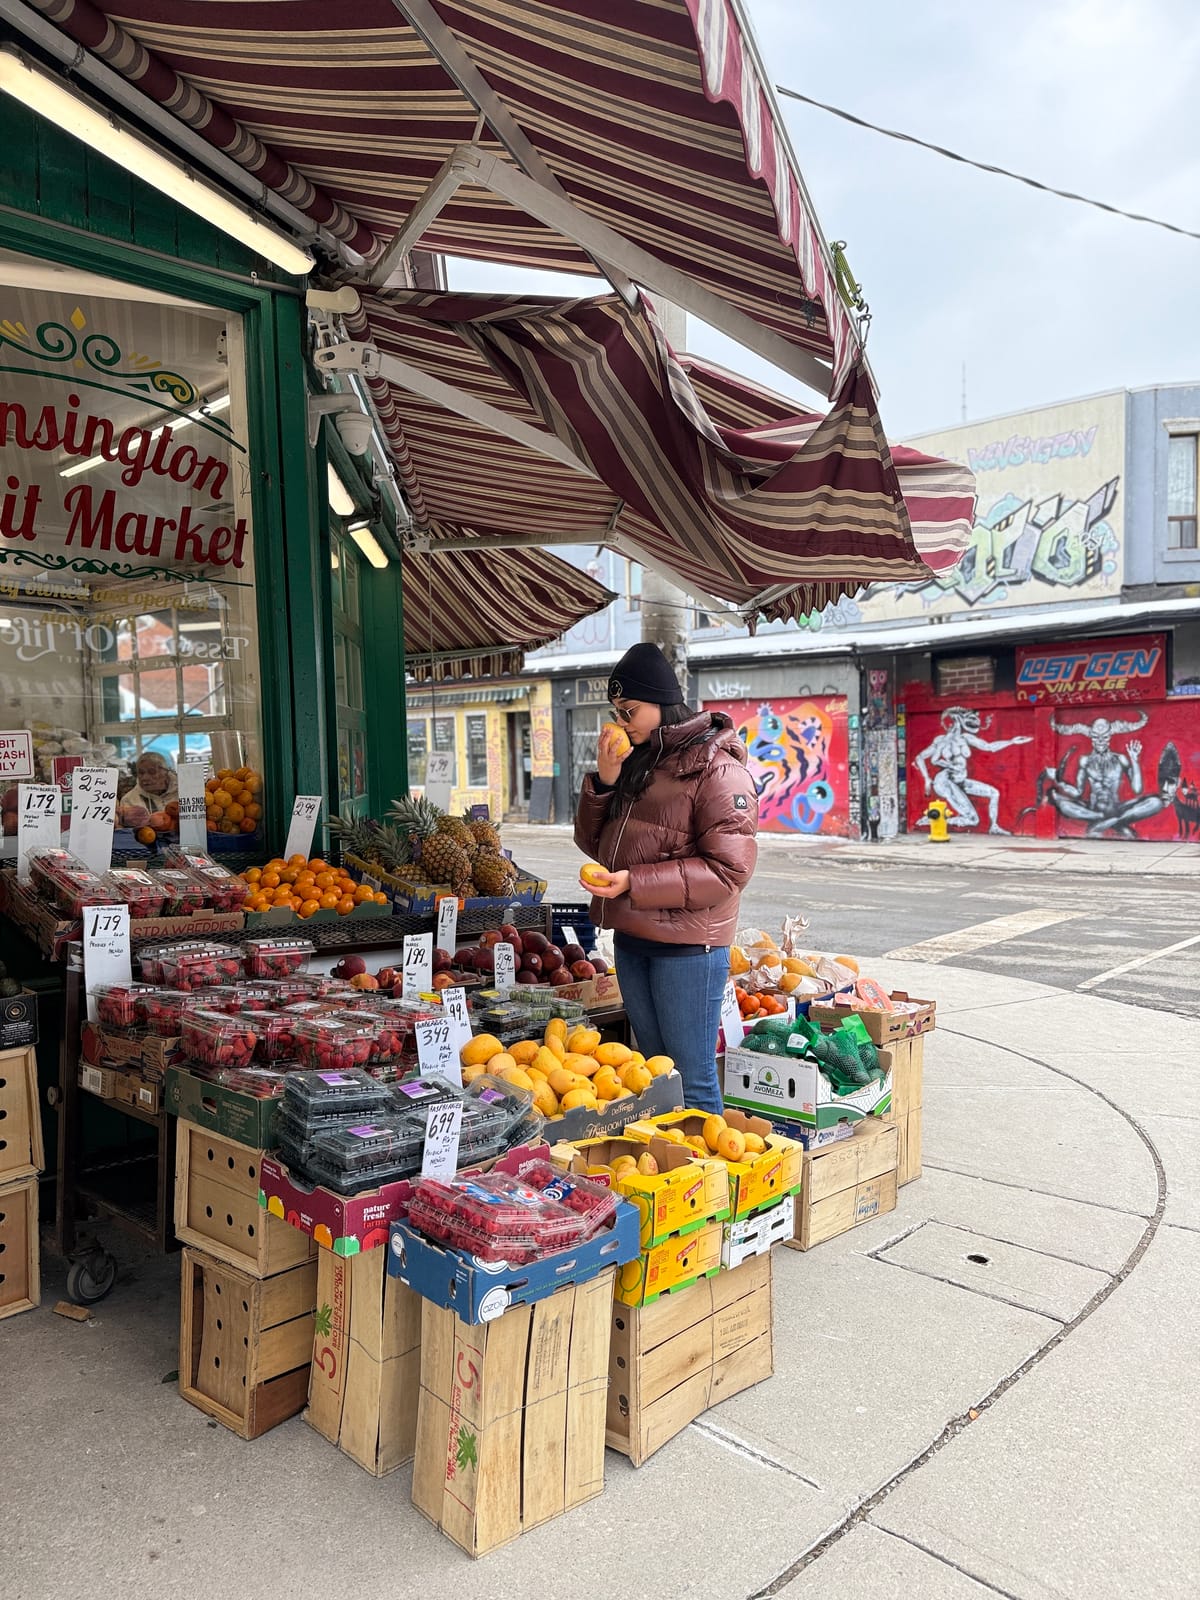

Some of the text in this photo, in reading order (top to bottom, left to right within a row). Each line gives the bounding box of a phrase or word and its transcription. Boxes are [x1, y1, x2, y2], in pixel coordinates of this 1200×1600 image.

[63, 484, 248, 569] Market
[24, 582, 91, 601] owned
[92, 587, 129, 605] and
[134, 592, 209, 613] operated
[1017, 648, 1161, 685] LOST GEN
[1045, 678, 1128, 693] VINTAGE
[79, 775, 92, 791] 2
[26, 793, 55, 810] 1.79
[90, 790, 116, 803] 3.00
[90, 914, 121, 937] 1.79
[133, 920, 238, 938] STRAWBERRIES
[428, 1112, 455, 1140] 6.99
[363, 1203, 391, 1214] nature
[363, 1211, 385, 1221] fresh
[363, 1219, 387, 1229] farms
